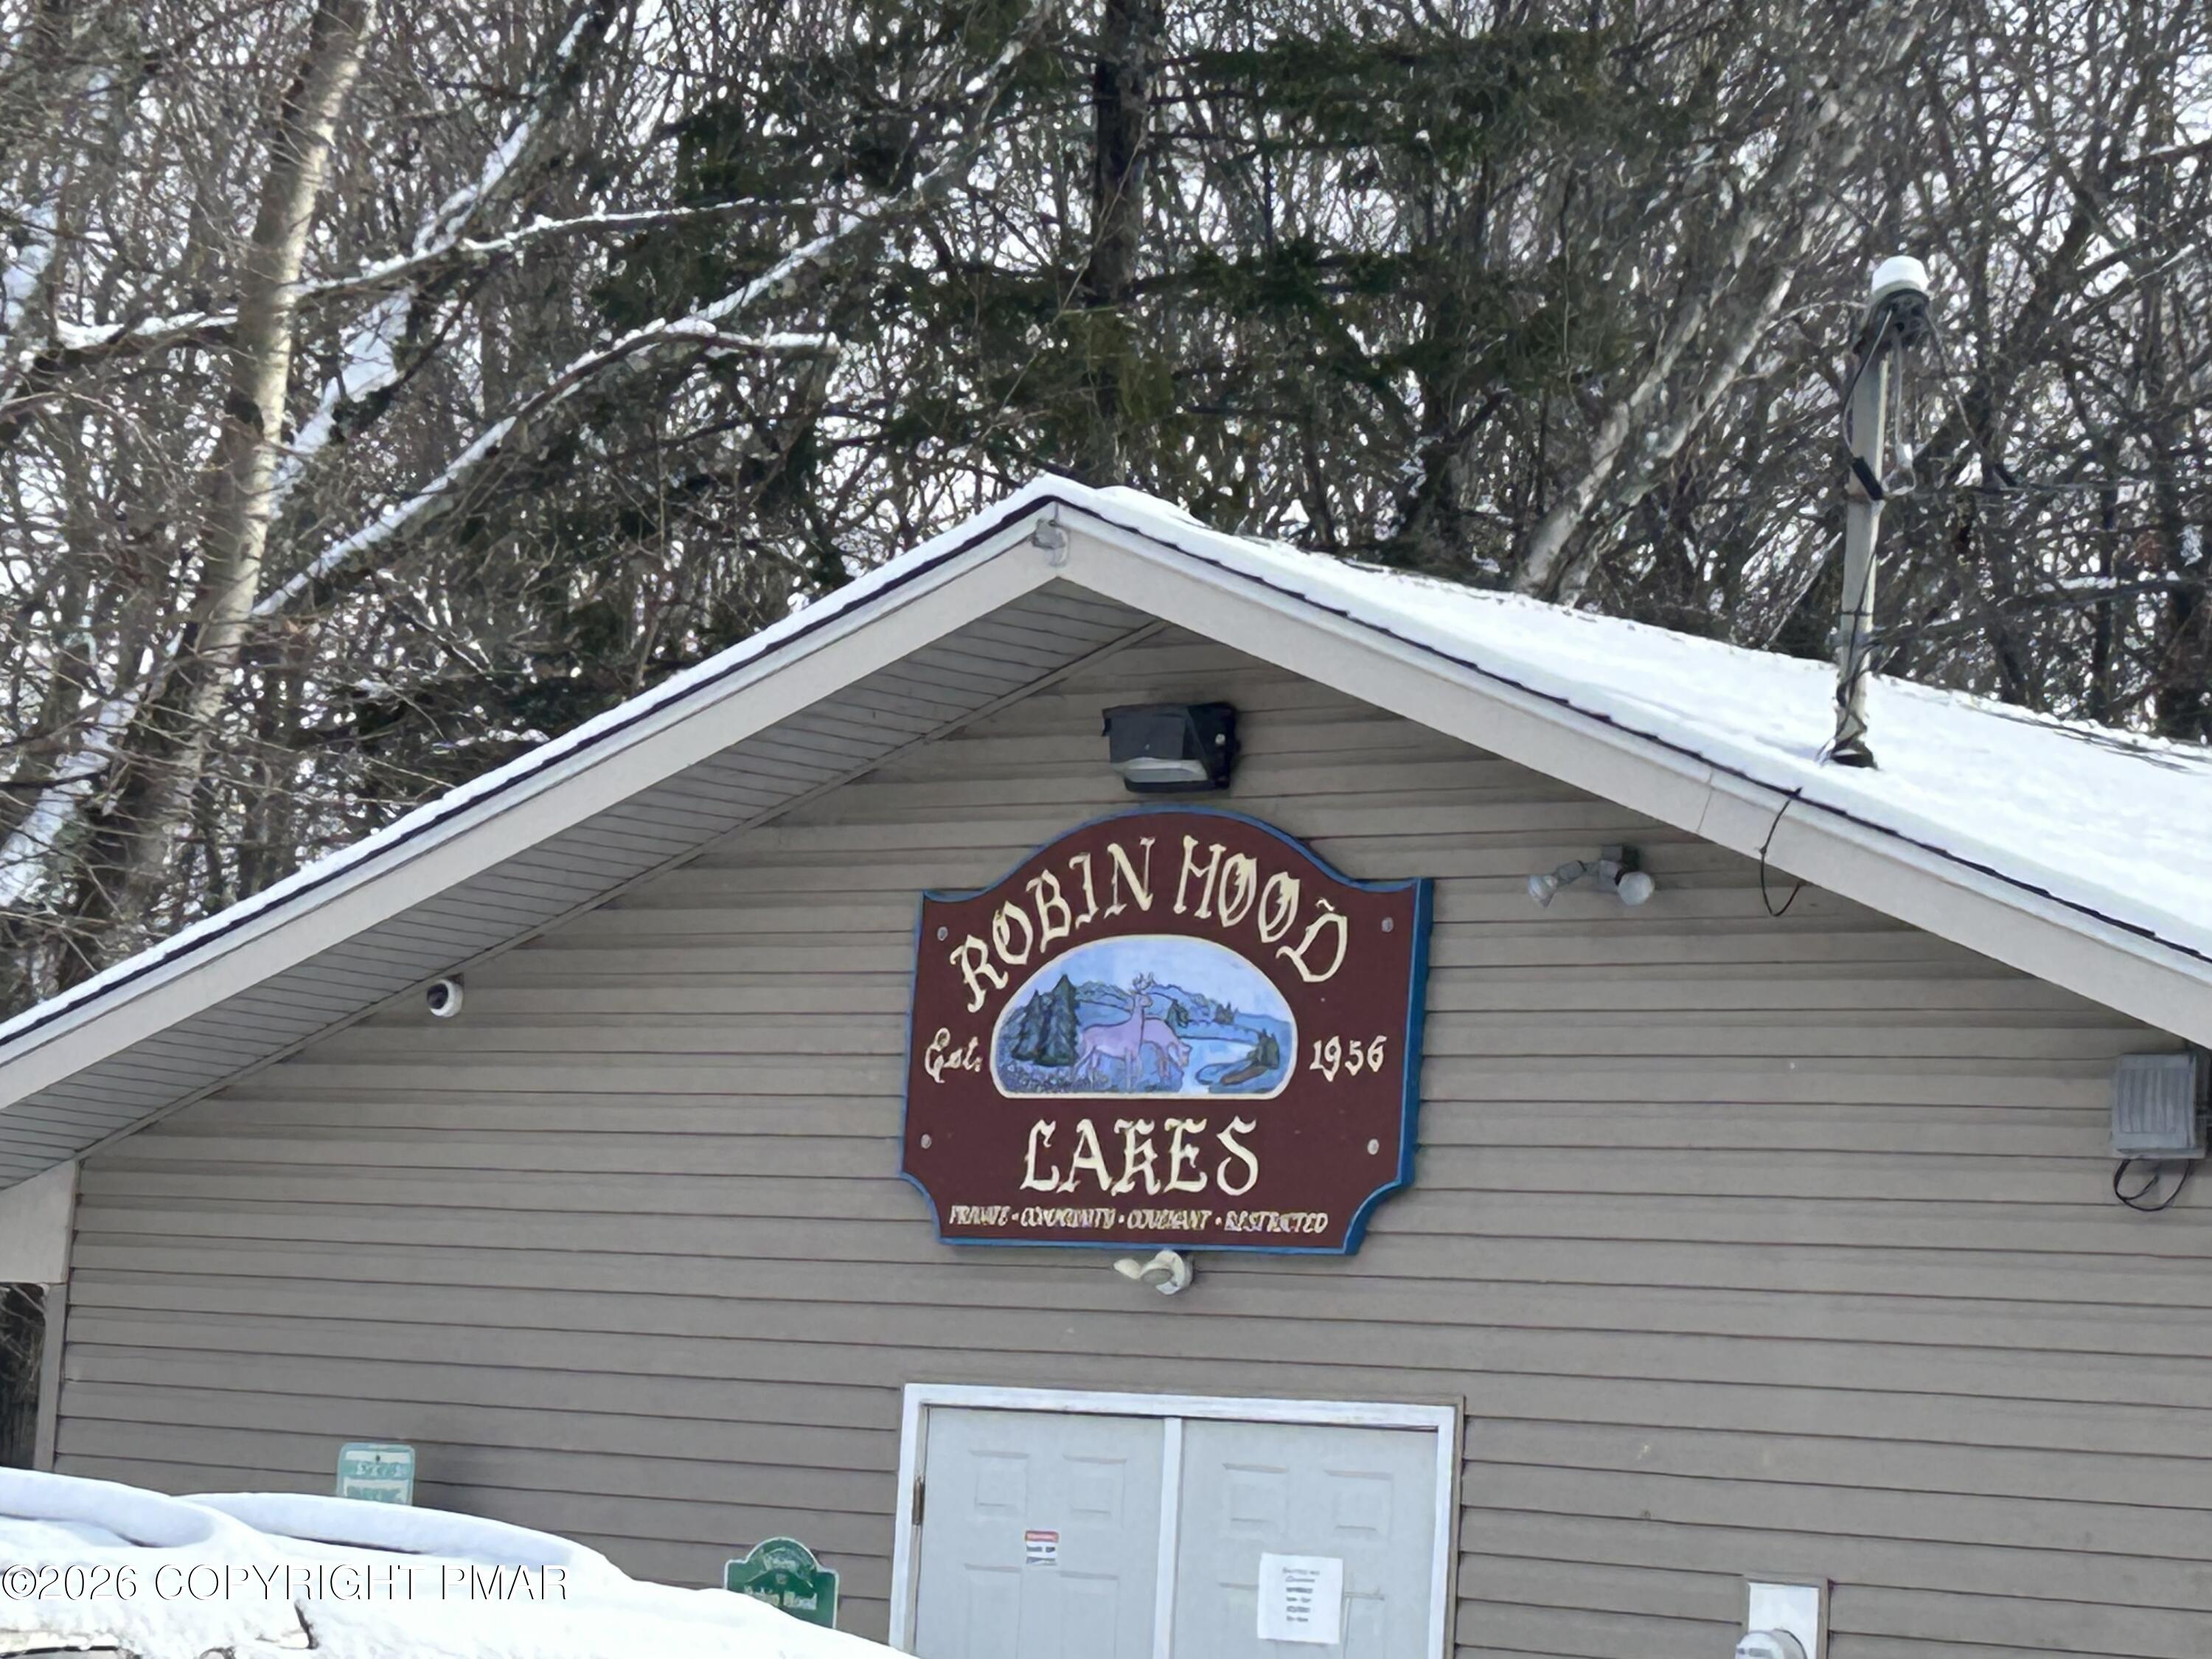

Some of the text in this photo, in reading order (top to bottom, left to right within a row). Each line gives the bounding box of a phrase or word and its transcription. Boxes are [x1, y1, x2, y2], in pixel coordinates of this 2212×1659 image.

[949, 834, 1349, 1014] ROBIN HOOD
[1309, 1034, 1388, 1082] 1956
[1019, 1116, 1259, 1197] LAKES
